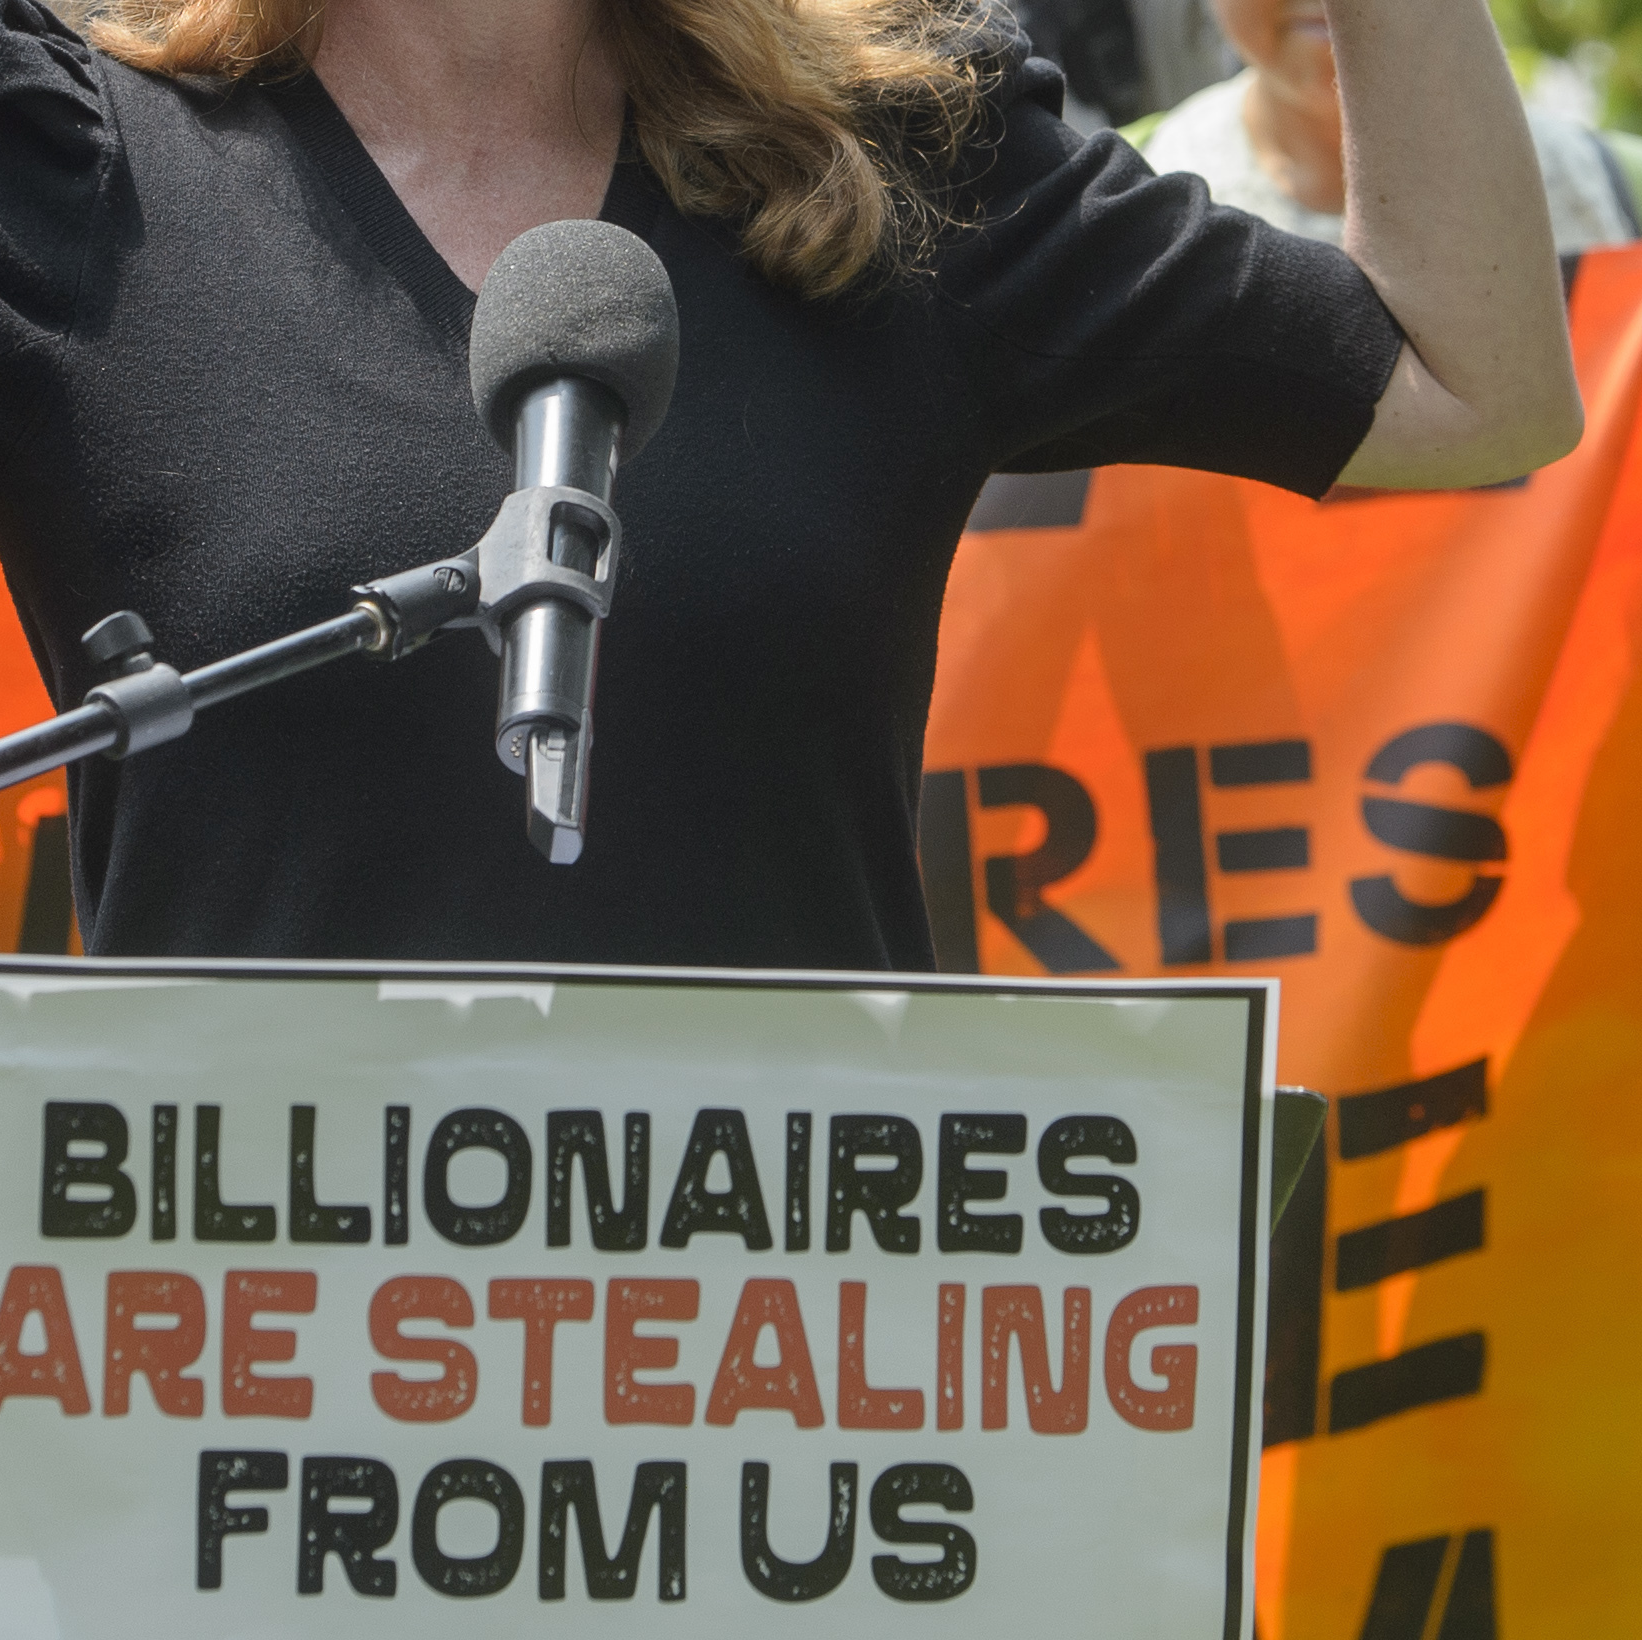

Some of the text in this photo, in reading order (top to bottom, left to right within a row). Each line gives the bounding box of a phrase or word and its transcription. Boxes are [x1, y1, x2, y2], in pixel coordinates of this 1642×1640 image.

[40, 1101, 1142, 1255] BILLIONAIRES
[367, 1274, 1201, 1435] STEALING
[195, 1450, 978, 1604] FROM US
